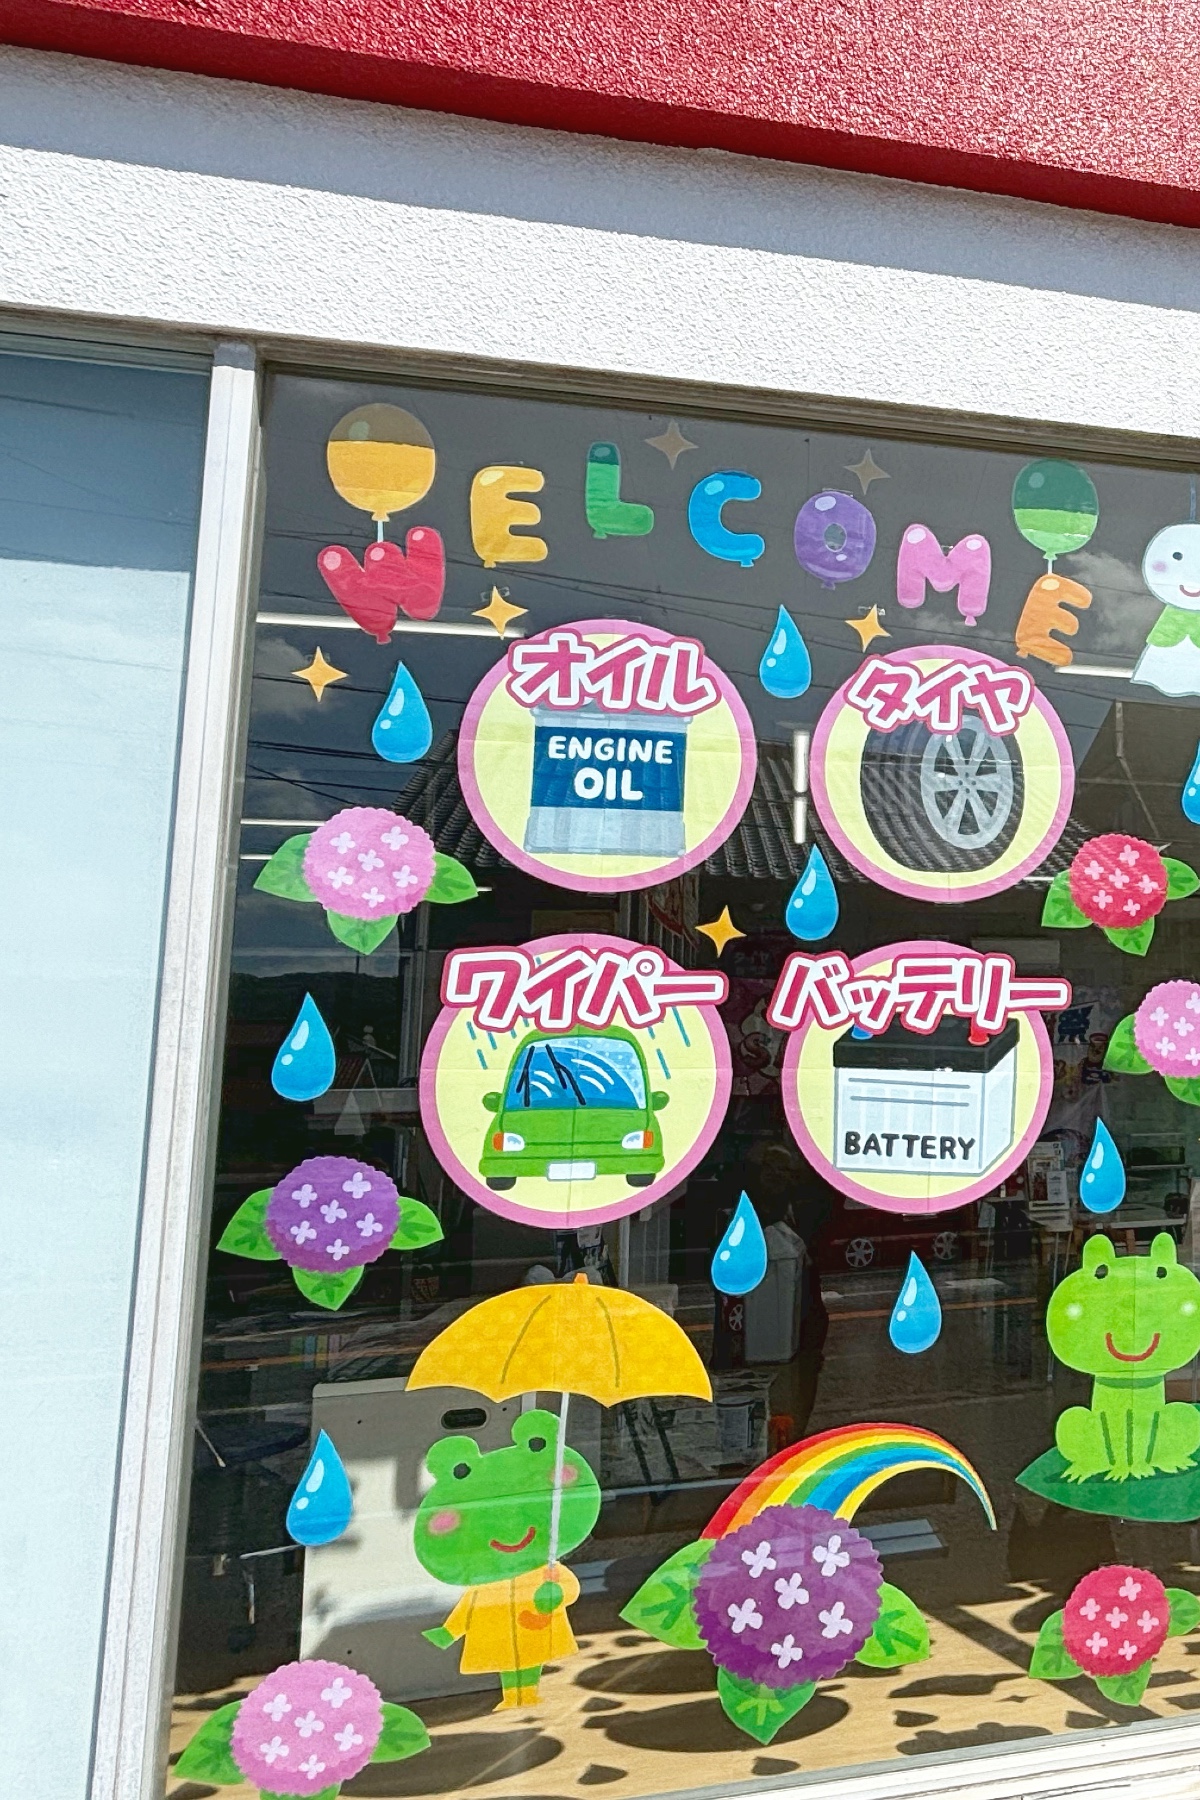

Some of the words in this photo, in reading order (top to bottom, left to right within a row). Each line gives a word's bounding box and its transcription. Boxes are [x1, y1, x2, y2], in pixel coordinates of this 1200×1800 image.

[317, 441, 1092, 666] WELCOME
[511, 632, 718, 713] オイル
[847, 656, 1033, 733] タイヤ
[548, 735, 674, 763] ENGINE
[574, 766, 643, 802] OIL
[444, 948, 726, 1030] ワイパー
[770, 952, 1069, 1032] バッテリー
[844, 1131, 975, 1162] BATTERY
